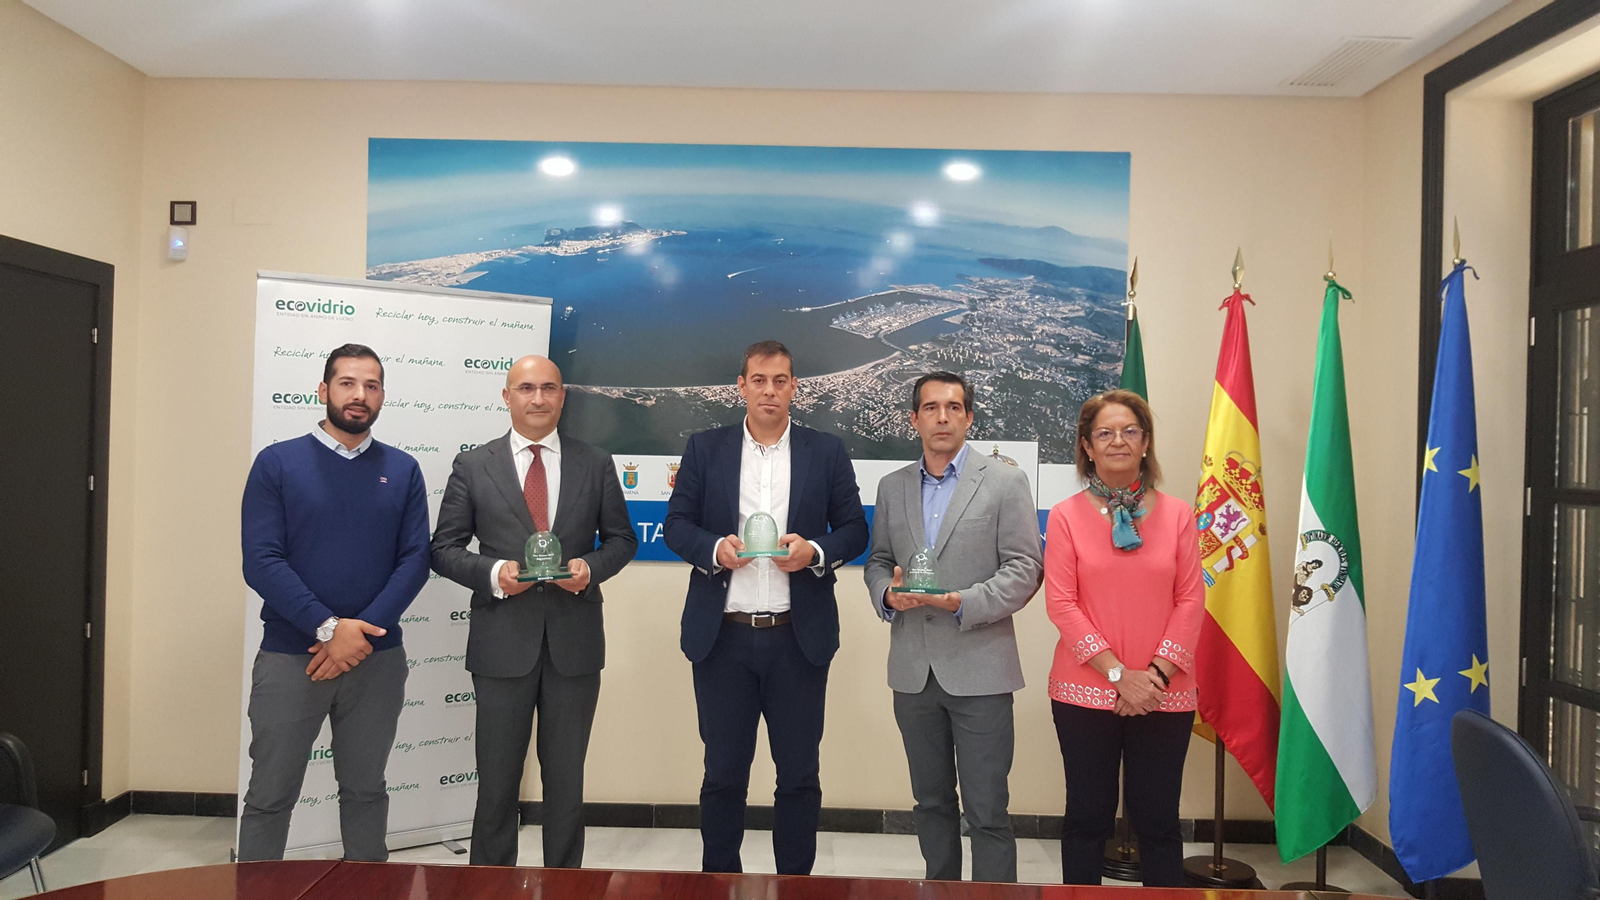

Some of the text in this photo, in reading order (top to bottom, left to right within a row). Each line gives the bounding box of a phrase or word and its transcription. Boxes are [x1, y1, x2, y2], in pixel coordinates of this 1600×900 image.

[275, 298, 356, 316] ecovidrio
[375, 307, 536, 331] Reciclar hoy, construir el mañana.
[273, 346, 332, 359] Reciclar ho
[395, 354, 404, 363] el
[408, 356, 446, 367] mañana.
[464, 356, 514, 371] ecovid
[383, 399, 410, 408] ciclar
[413, 400, 435, 413] hoy,
[438, 401, 481, 411] construir
[484, 403, 494, 411] el
[404, 443, 441, 453] mañana.
[637, 522, 664, 543] TA
[406, 659, 421, 669] oy,
[445, 692, 476, 703] ecov
[394, 731, 473, 753] hoy, construir el
[440, 768, 478, 785] ecovi
[299, 795, 322, 807] hoy,
